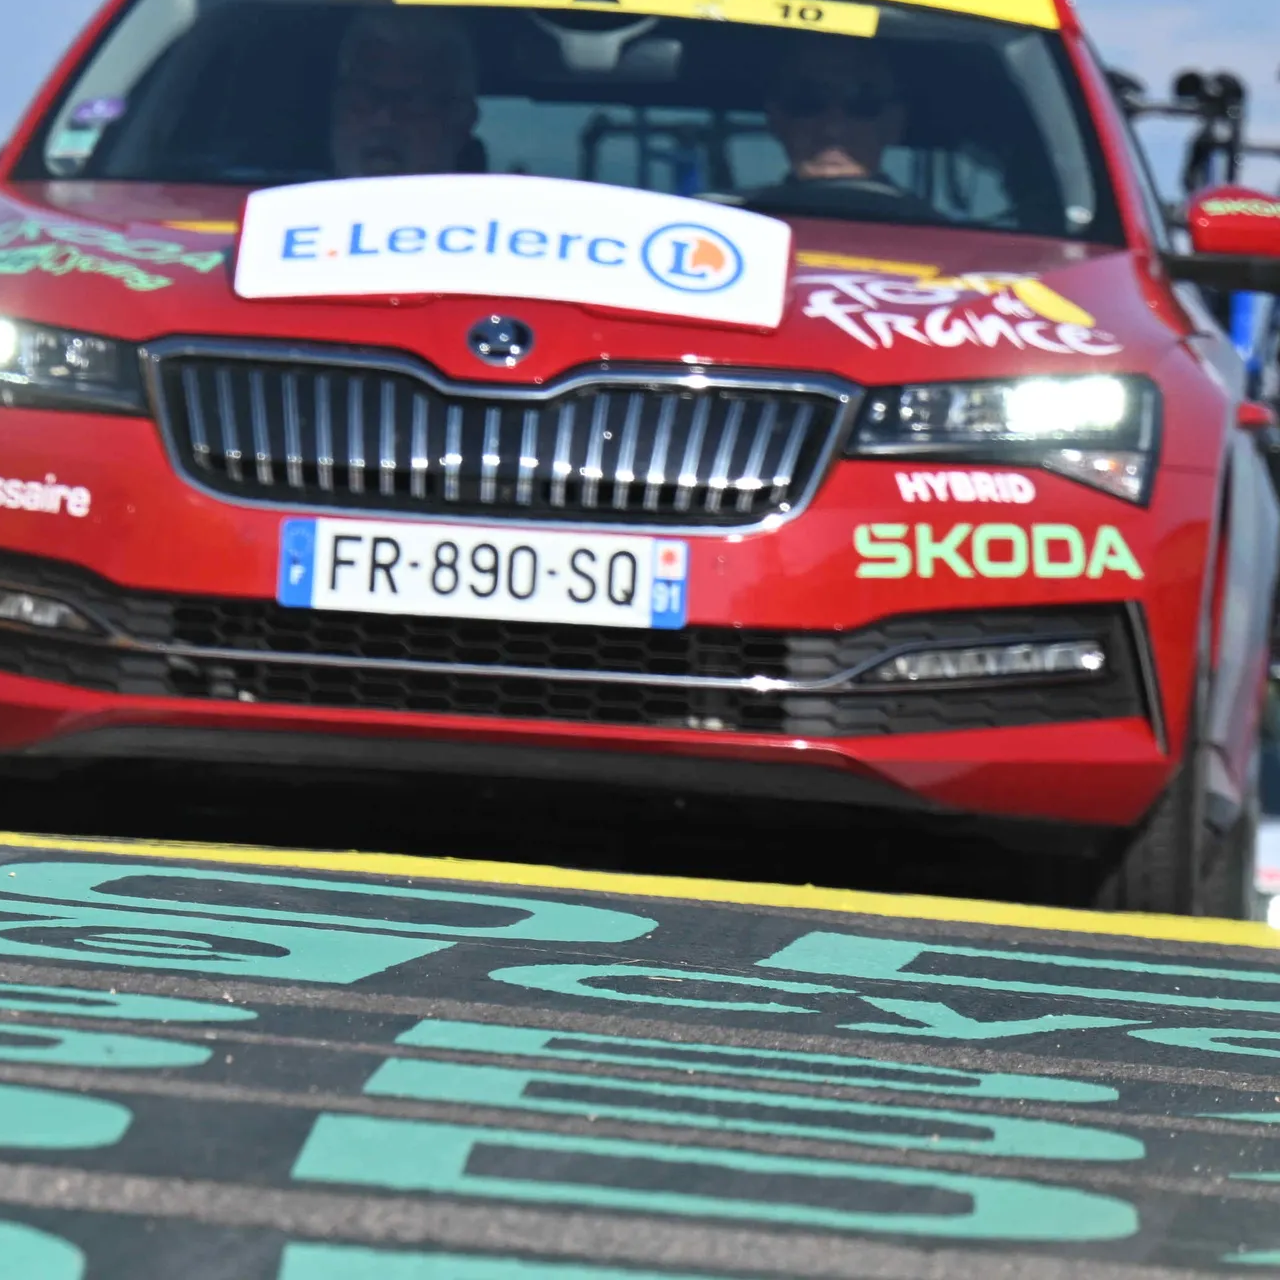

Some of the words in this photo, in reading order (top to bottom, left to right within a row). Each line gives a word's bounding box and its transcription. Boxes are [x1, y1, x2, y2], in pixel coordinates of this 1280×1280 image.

[777, 1, 825, 25] 10
[281, 220, 626, 267] E.Leclerc
[894, 471, 1036, 505] HYBRID
[329, 534, 639, 607] FR-890-SQ
